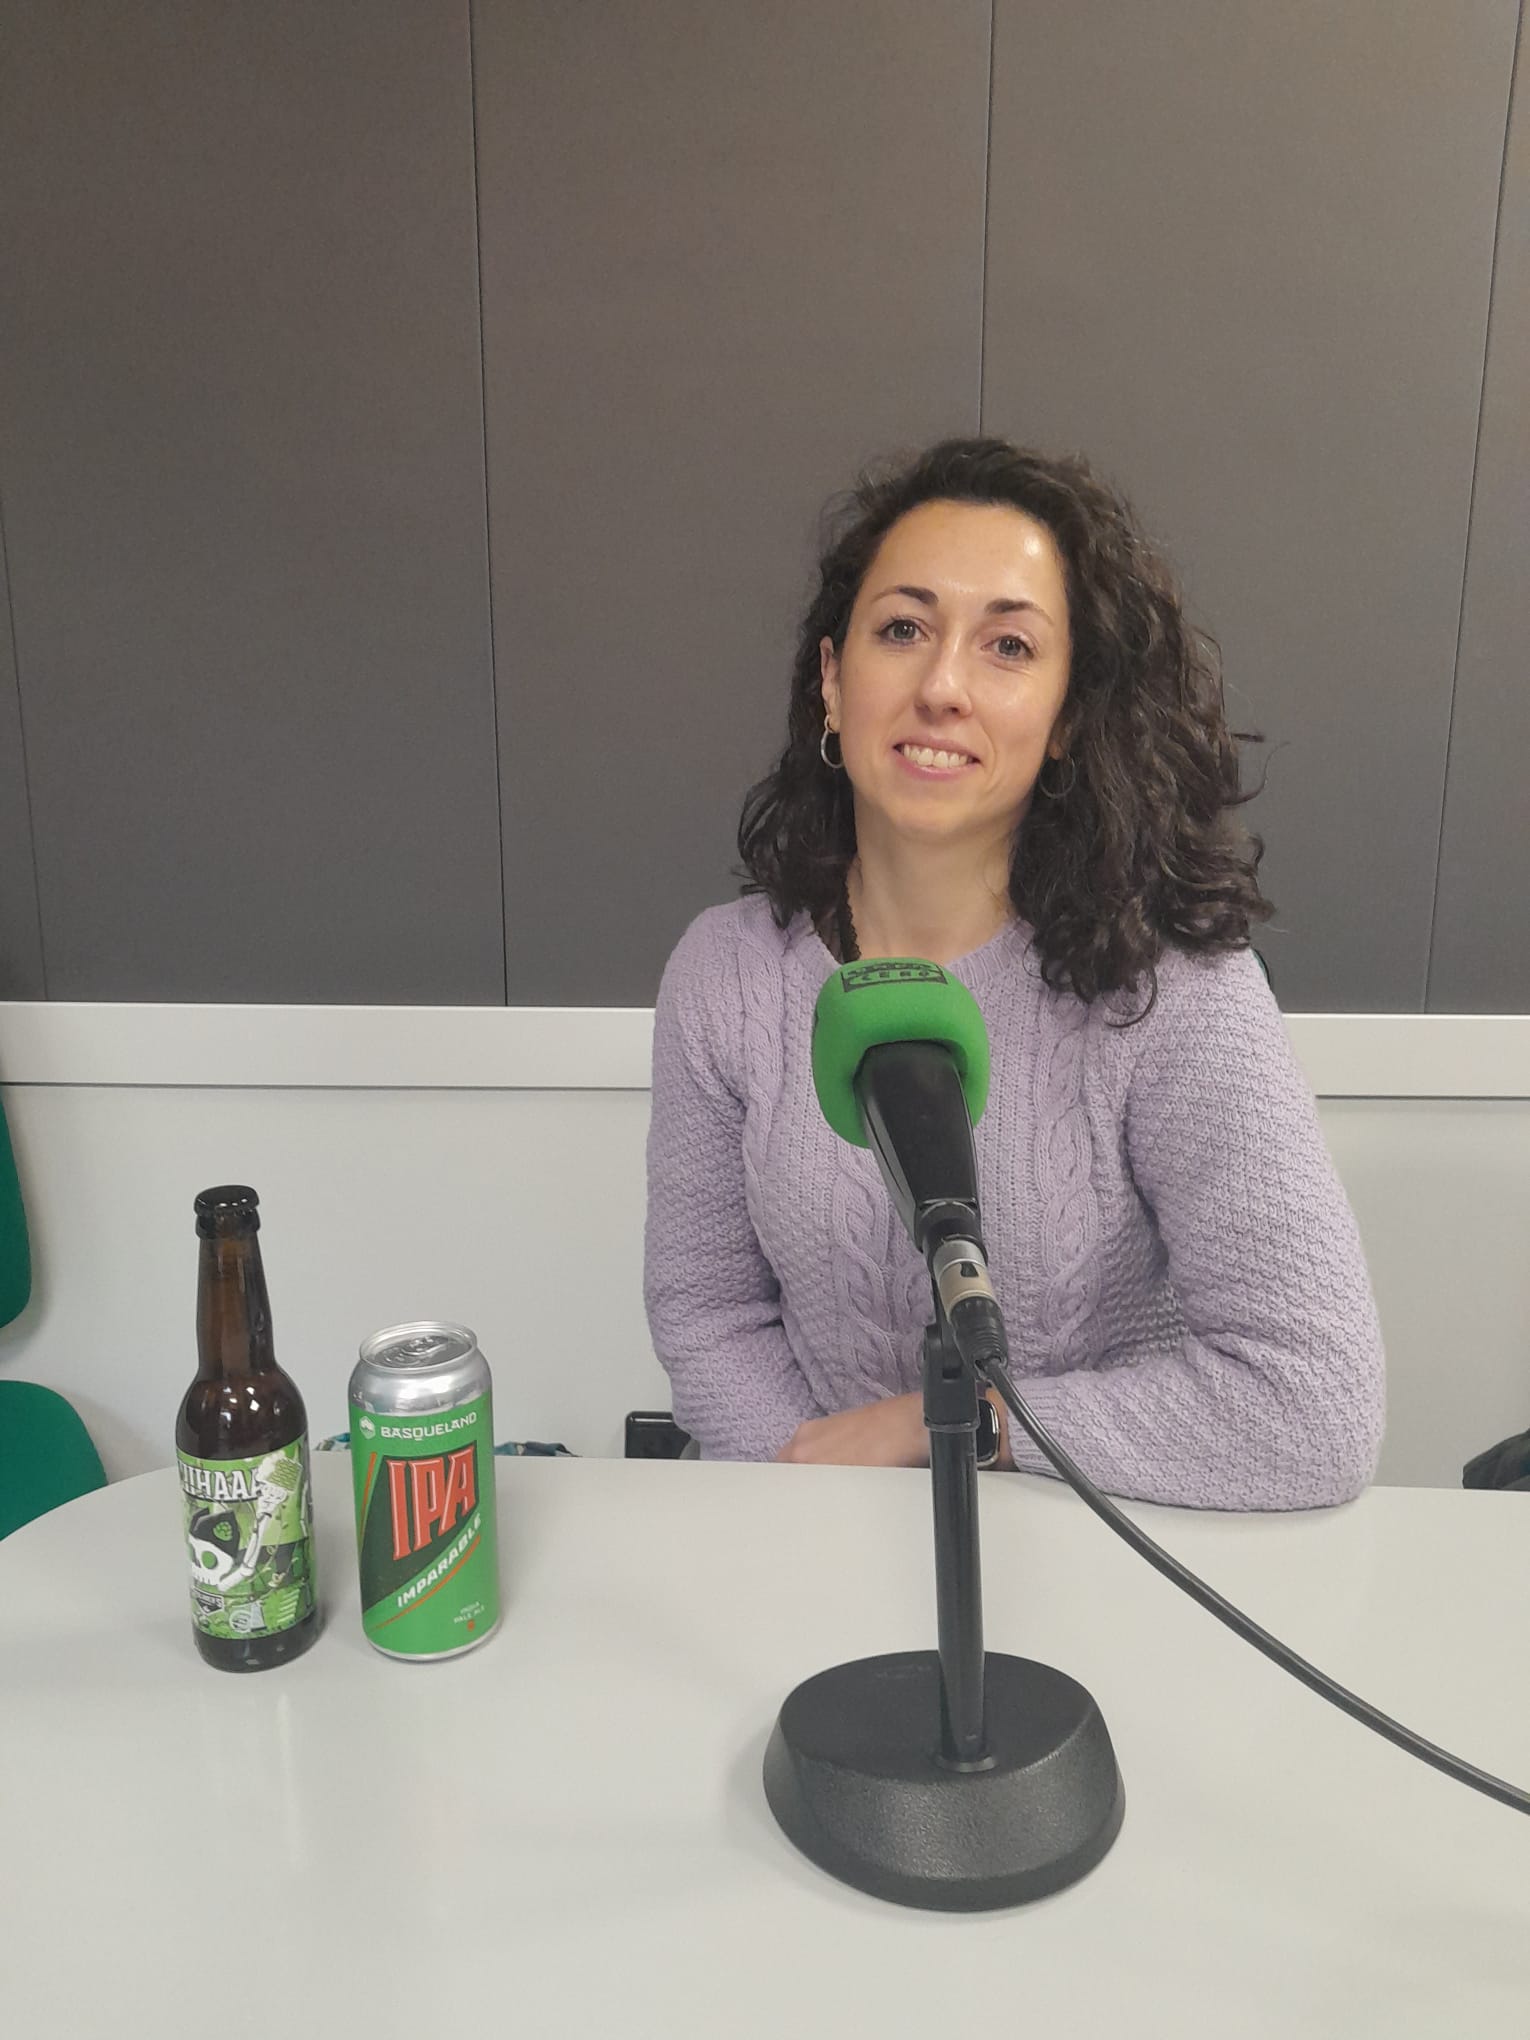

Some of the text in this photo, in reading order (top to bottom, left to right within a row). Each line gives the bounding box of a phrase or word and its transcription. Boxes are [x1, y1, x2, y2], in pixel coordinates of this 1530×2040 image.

[380, 1411, 477, 1441] BASQUELAND
[386, 1445, 476, 1561] IPA
[397, 1512, 481, 1608] IMPARABLE
